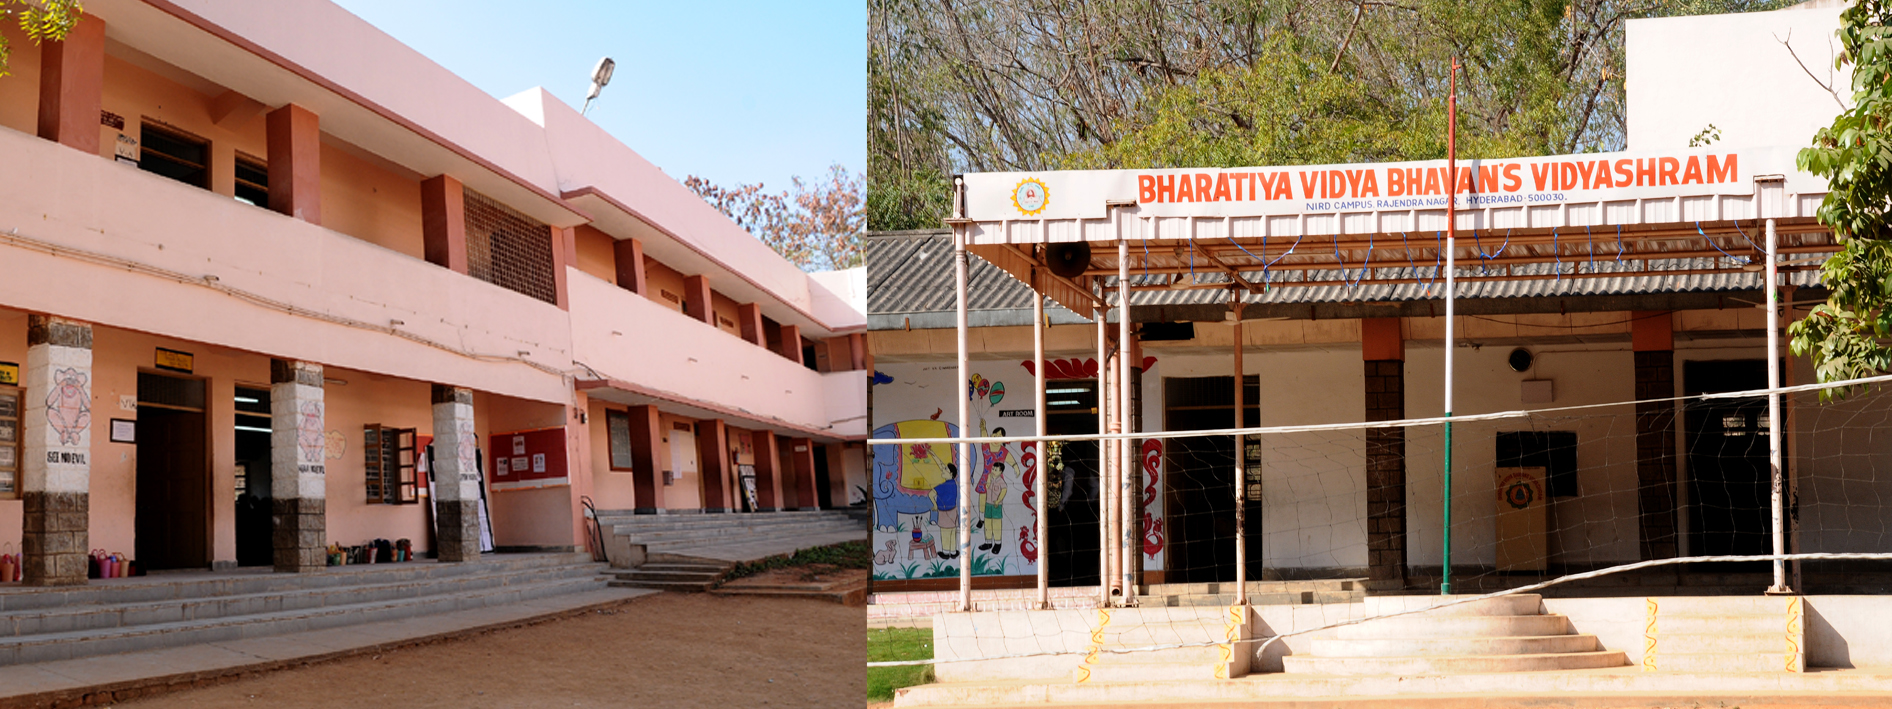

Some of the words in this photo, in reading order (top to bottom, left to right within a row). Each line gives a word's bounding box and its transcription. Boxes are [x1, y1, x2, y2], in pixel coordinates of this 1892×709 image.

[1138, 171, 1293, 204] BHARATIYA
[1299, 169, 1380, 199] VIDYA
[1387, 163, 1522, 197] BHAVAN'S
[1530, 153, 1738, 192] VIDYASHRAM
[1306, 202, 1331, 211] NIRD
[1376, 199, 1424, 208] RAJENDRA
[47, 451, 59, 463] SEE
[61, 452, 71, 463] NO
